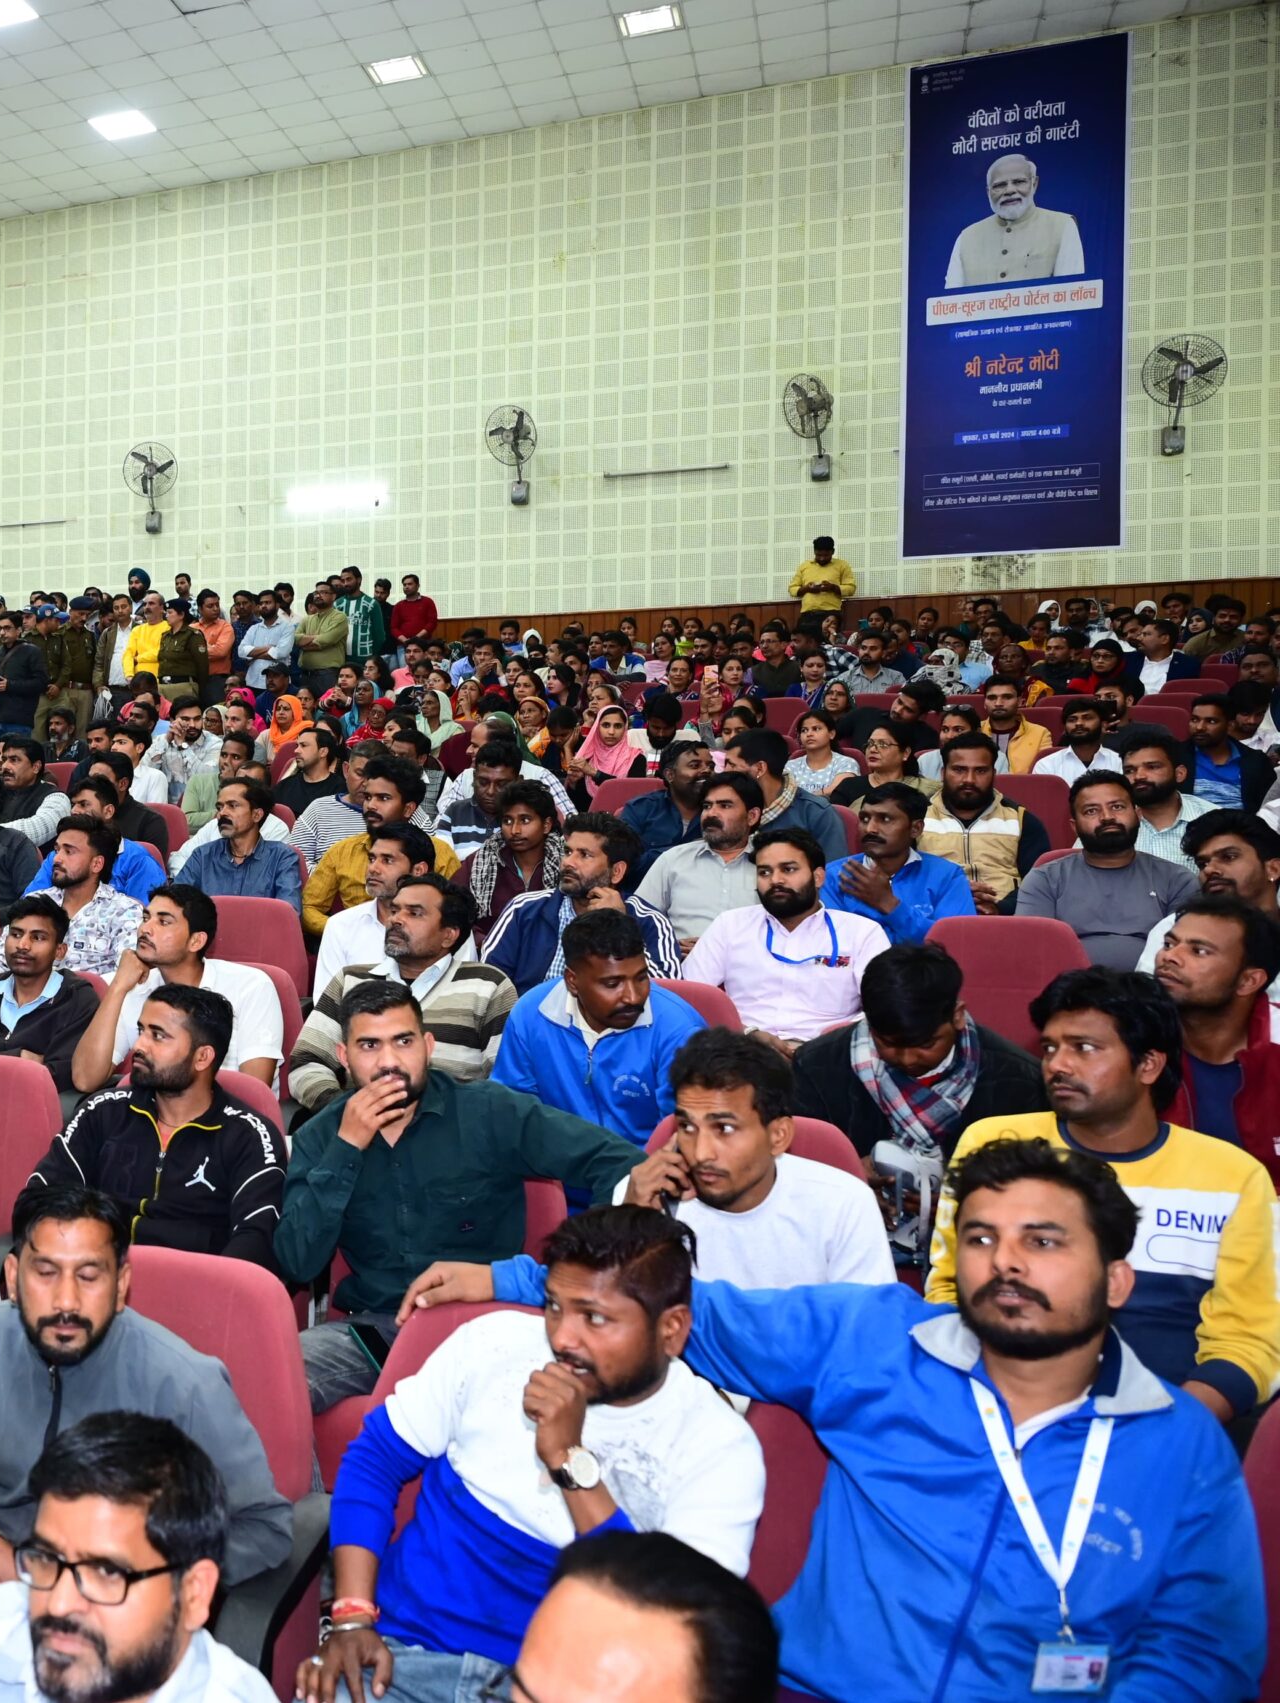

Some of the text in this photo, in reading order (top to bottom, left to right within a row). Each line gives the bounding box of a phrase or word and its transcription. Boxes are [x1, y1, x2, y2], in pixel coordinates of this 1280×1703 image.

[968, 100, 1066, 129] वंचितों को वरीयता
[952, 120, 1080, 155] मोदी सरकार की गारंटी
[989, 293, 1020, 310] राष्ट्रीय
[1024, 290, 1049, 306] पोर्टल
[1054, 291, 1066, 303] का
[964, 348, 1060, 378] श्री नरेन्द्र मोदी
